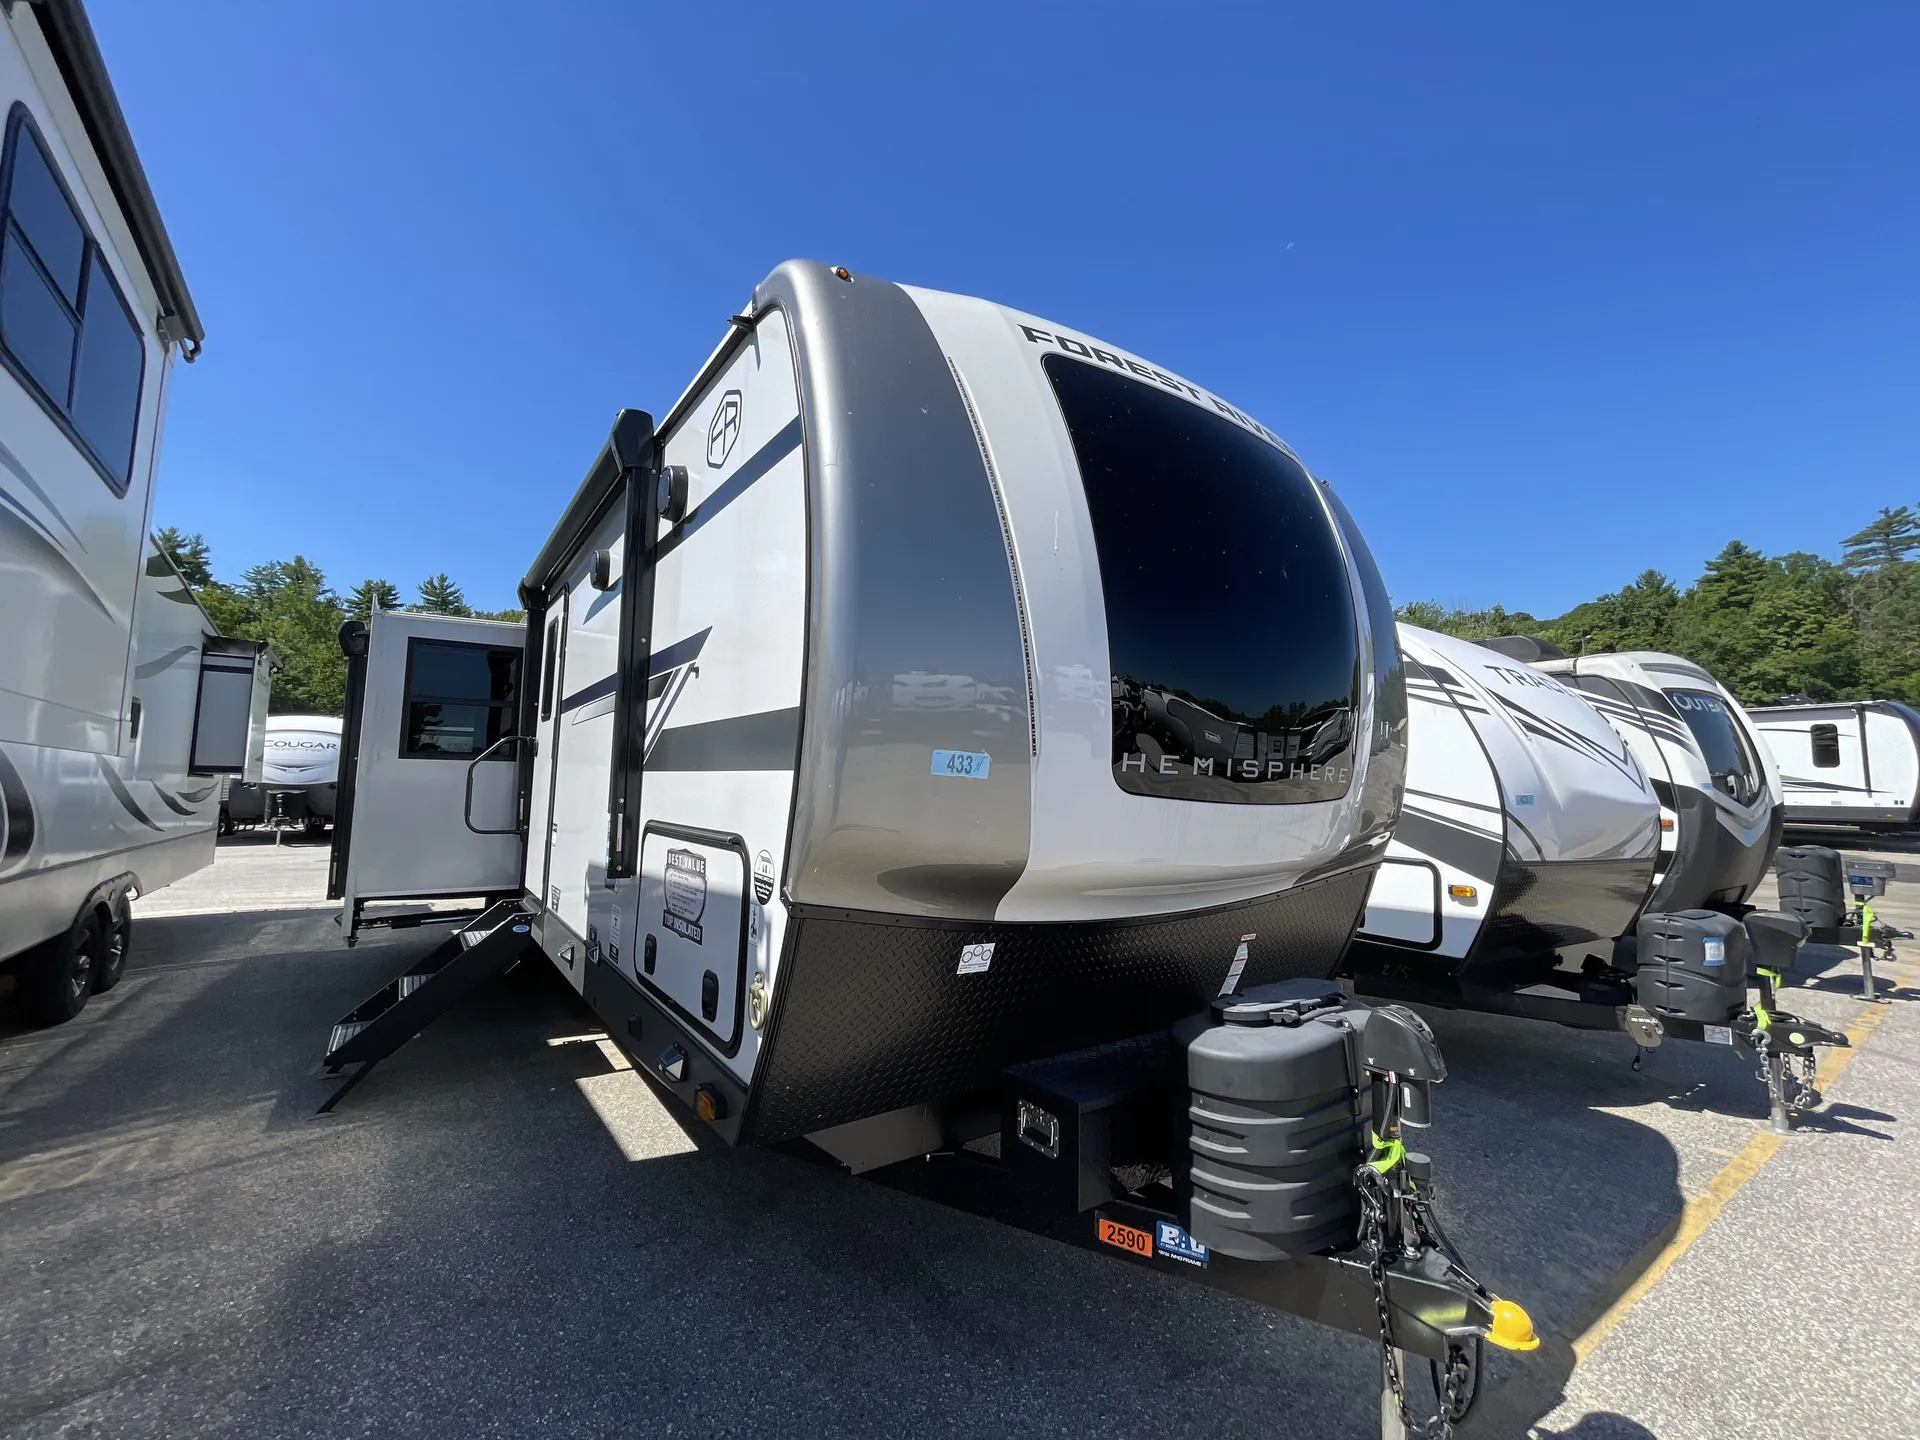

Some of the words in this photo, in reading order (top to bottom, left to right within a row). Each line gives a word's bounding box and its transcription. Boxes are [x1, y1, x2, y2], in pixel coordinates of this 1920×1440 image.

[1017, 323, 1204, 401] FOREST
[264, 739, 338, 750] COUGAR
[946, 753, 974, 775] 433
[1121, 752, 1349, 785] HEMISPHERE
[668, 852, 683, 868] BEST
[683, 856, 706, 874] VALUE
[673, 916, 702, 942] INSULATED
[1106, 1224, 1146, 1252] 2590
